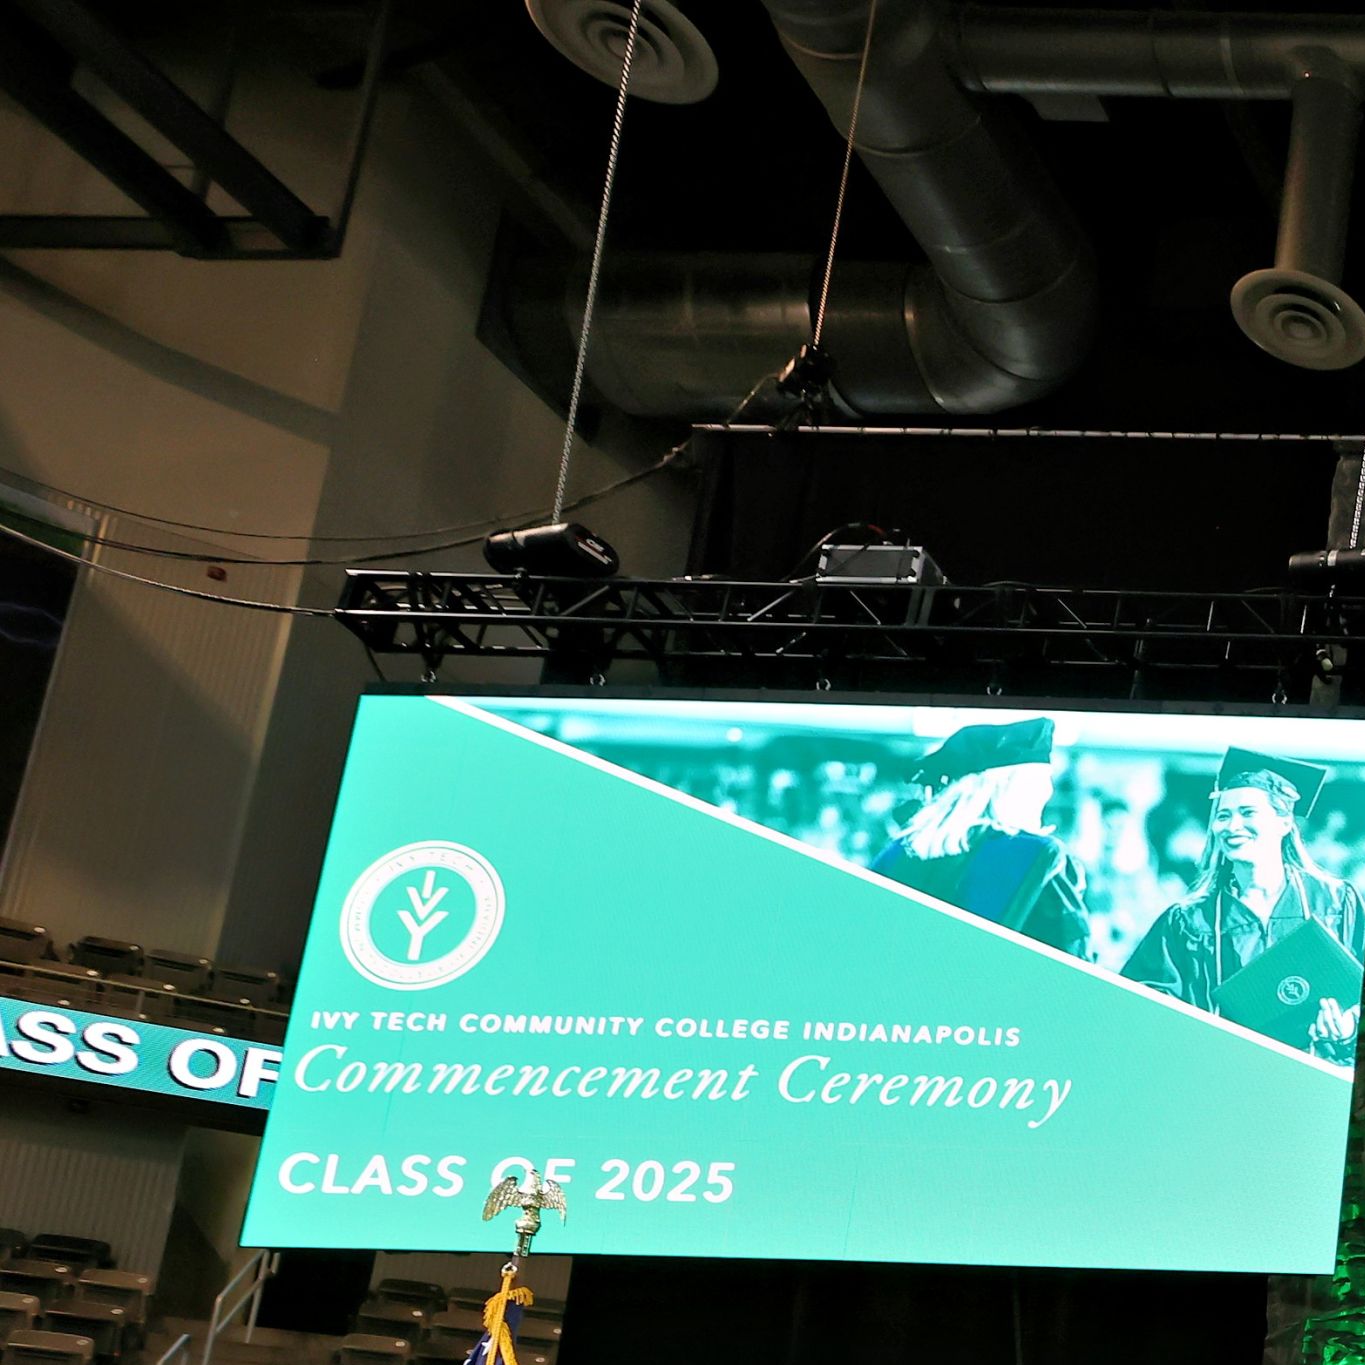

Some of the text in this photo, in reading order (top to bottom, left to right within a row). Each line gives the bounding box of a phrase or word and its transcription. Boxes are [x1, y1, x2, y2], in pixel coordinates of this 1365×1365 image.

[0, 1008, 284, 1099] SS OF
[310, 1010, 1021, 1048] IVY TECH COMMUNITY COLLEGE INDIANAPOLIS
[293, 1043, 1073, 1130] Commencement Ceremony
[276, 1151, 468, 1199] CLASS
[593, 1157, 736, 1204] 2025
